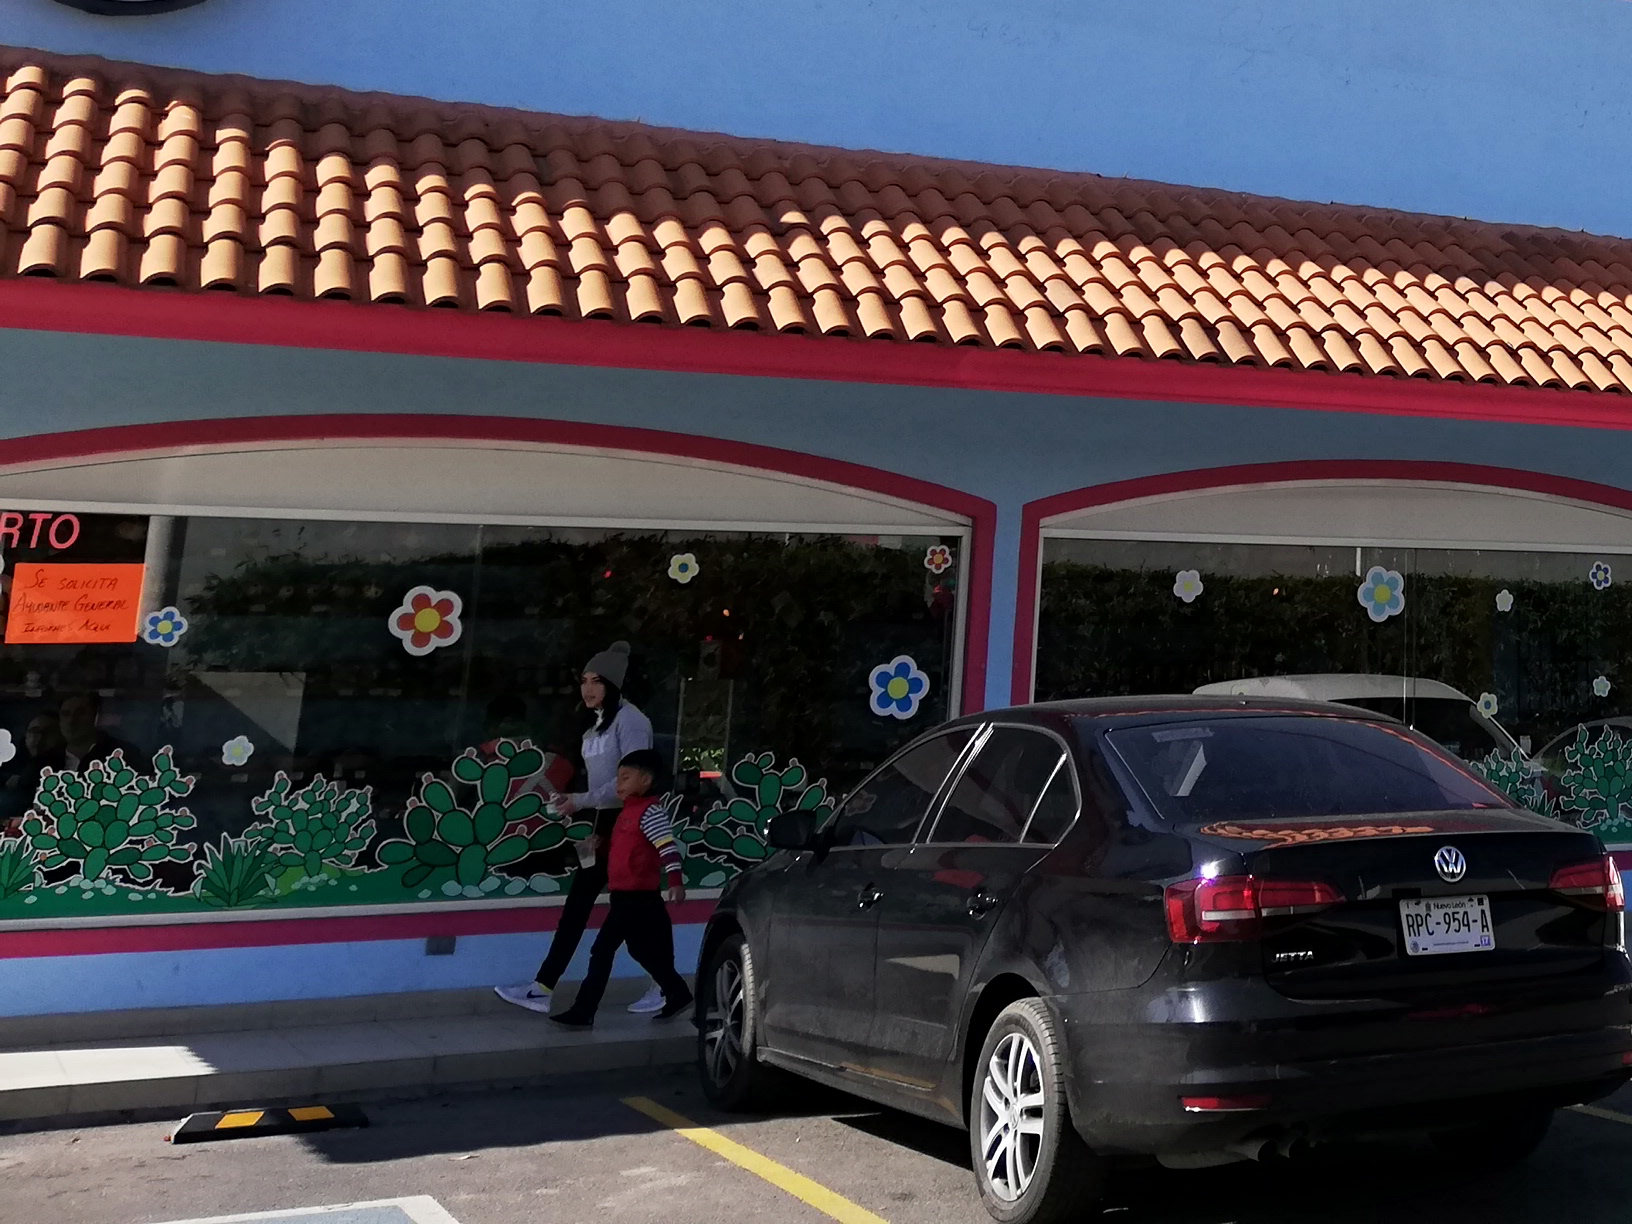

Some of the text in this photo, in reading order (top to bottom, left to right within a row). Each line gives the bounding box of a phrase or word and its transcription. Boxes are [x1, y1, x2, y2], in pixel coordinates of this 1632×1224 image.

[1433, 900, 1467, 910] Nuevo León
[1405, 908, 1490, 938] RPC-954-A
[1270, 950, 1315, 963] JETTA
